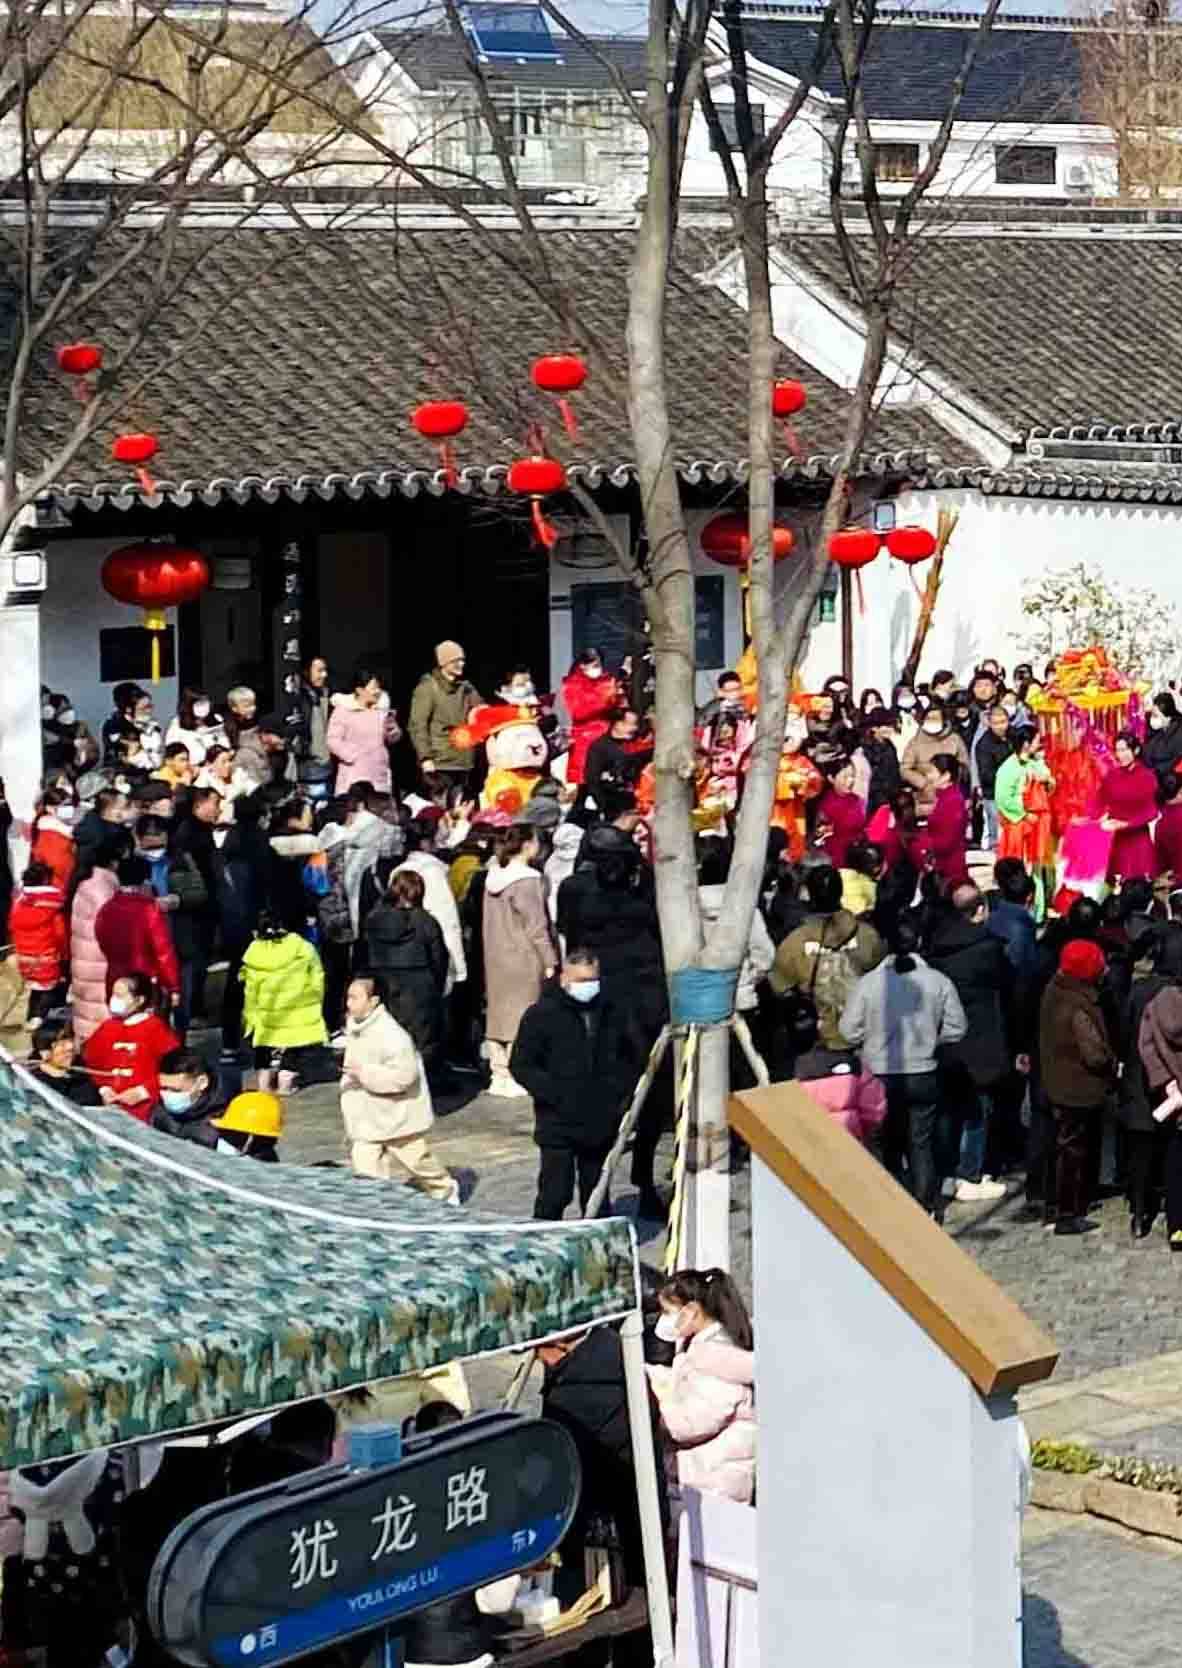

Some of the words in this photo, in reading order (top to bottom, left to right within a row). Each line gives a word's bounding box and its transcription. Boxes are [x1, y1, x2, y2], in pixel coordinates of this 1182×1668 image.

[290, 1466, 489, 1589] 犹龙路
[345, 1575, 417, 1612] YOULONG
[419, 1566, 439, 1587] LU
[260, 1624, 279, 1649] 西
